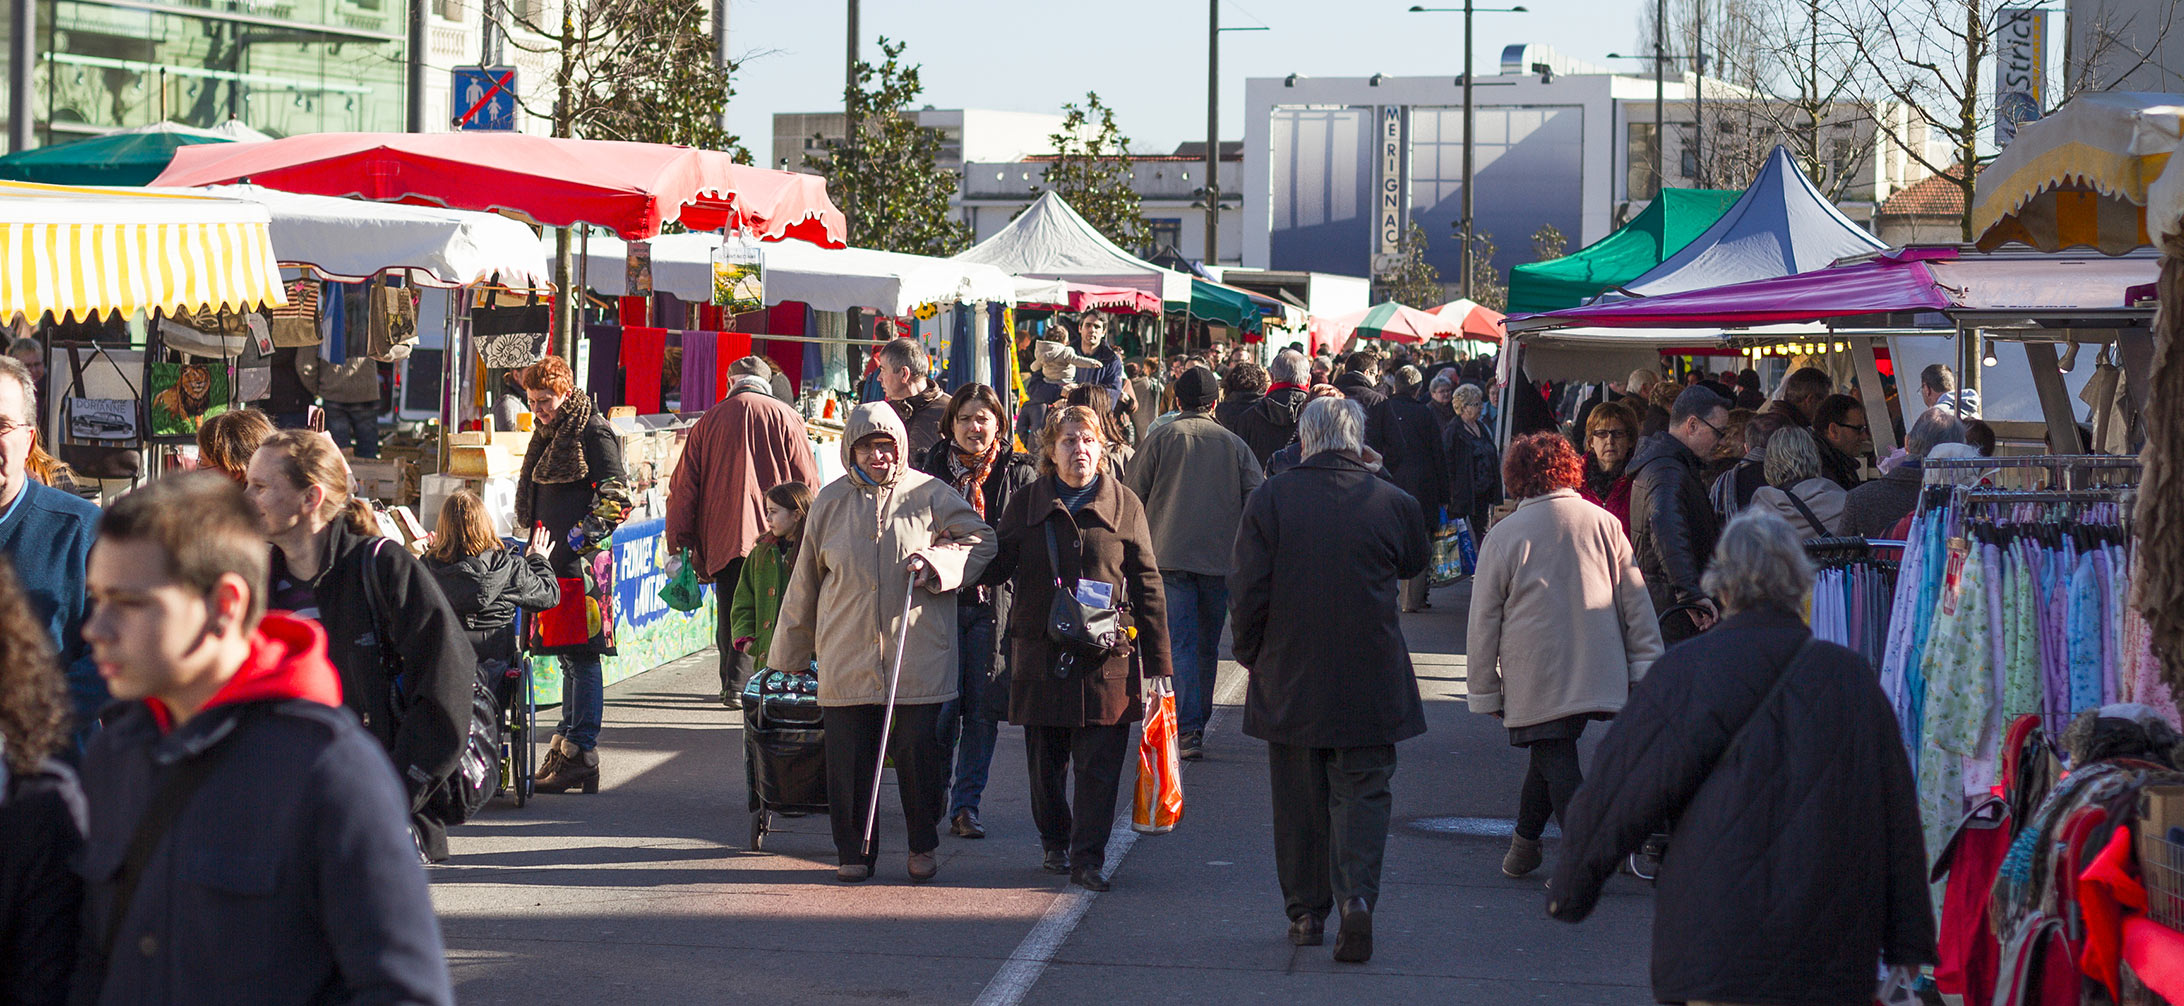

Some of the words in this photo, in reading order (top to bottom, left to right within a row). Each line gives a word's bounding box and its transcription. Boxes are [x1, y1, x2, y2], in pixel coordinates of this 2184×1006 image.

[2006, 12, 2031, 91] Strict
[1385, 108, 1399, 243] MERIGNAC
[76, 400, 126, 413] DORIANNE
